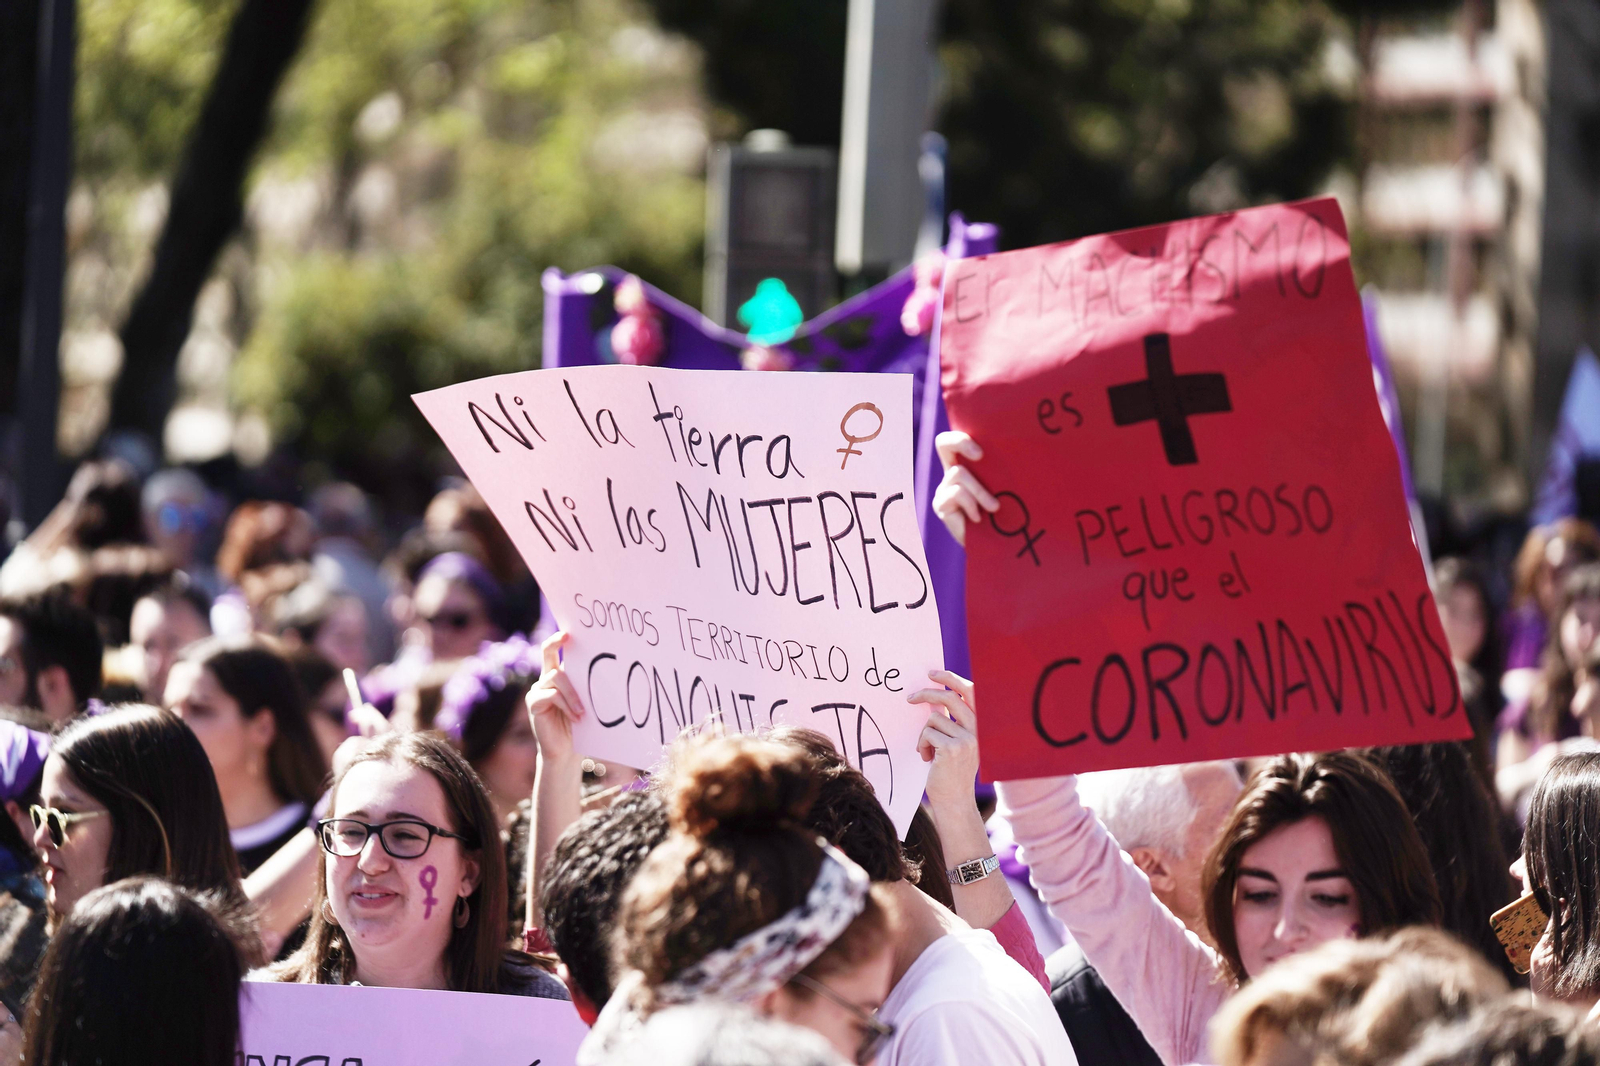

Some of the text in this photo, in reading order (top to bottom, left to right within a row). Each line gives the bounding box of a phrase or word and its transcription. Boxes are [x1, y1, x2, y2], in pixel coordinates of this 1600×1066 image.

[1037, 213, 1328, 330] MACHISMO
[467, 379, 806, 479] Ni la tierra
[1036, 392, 1084, 434] es
[524, 478, 929, 613] Ni las MUJERES
[1075, 483, 1334, 565] PELIGROSO
[1122, 551, 1251, 631] que el
[665, 604, 850, 683] TERRITORIO
[863, 647, 905, 692] de
[1031, 591, 1459, 747] CORONAVIRUS
